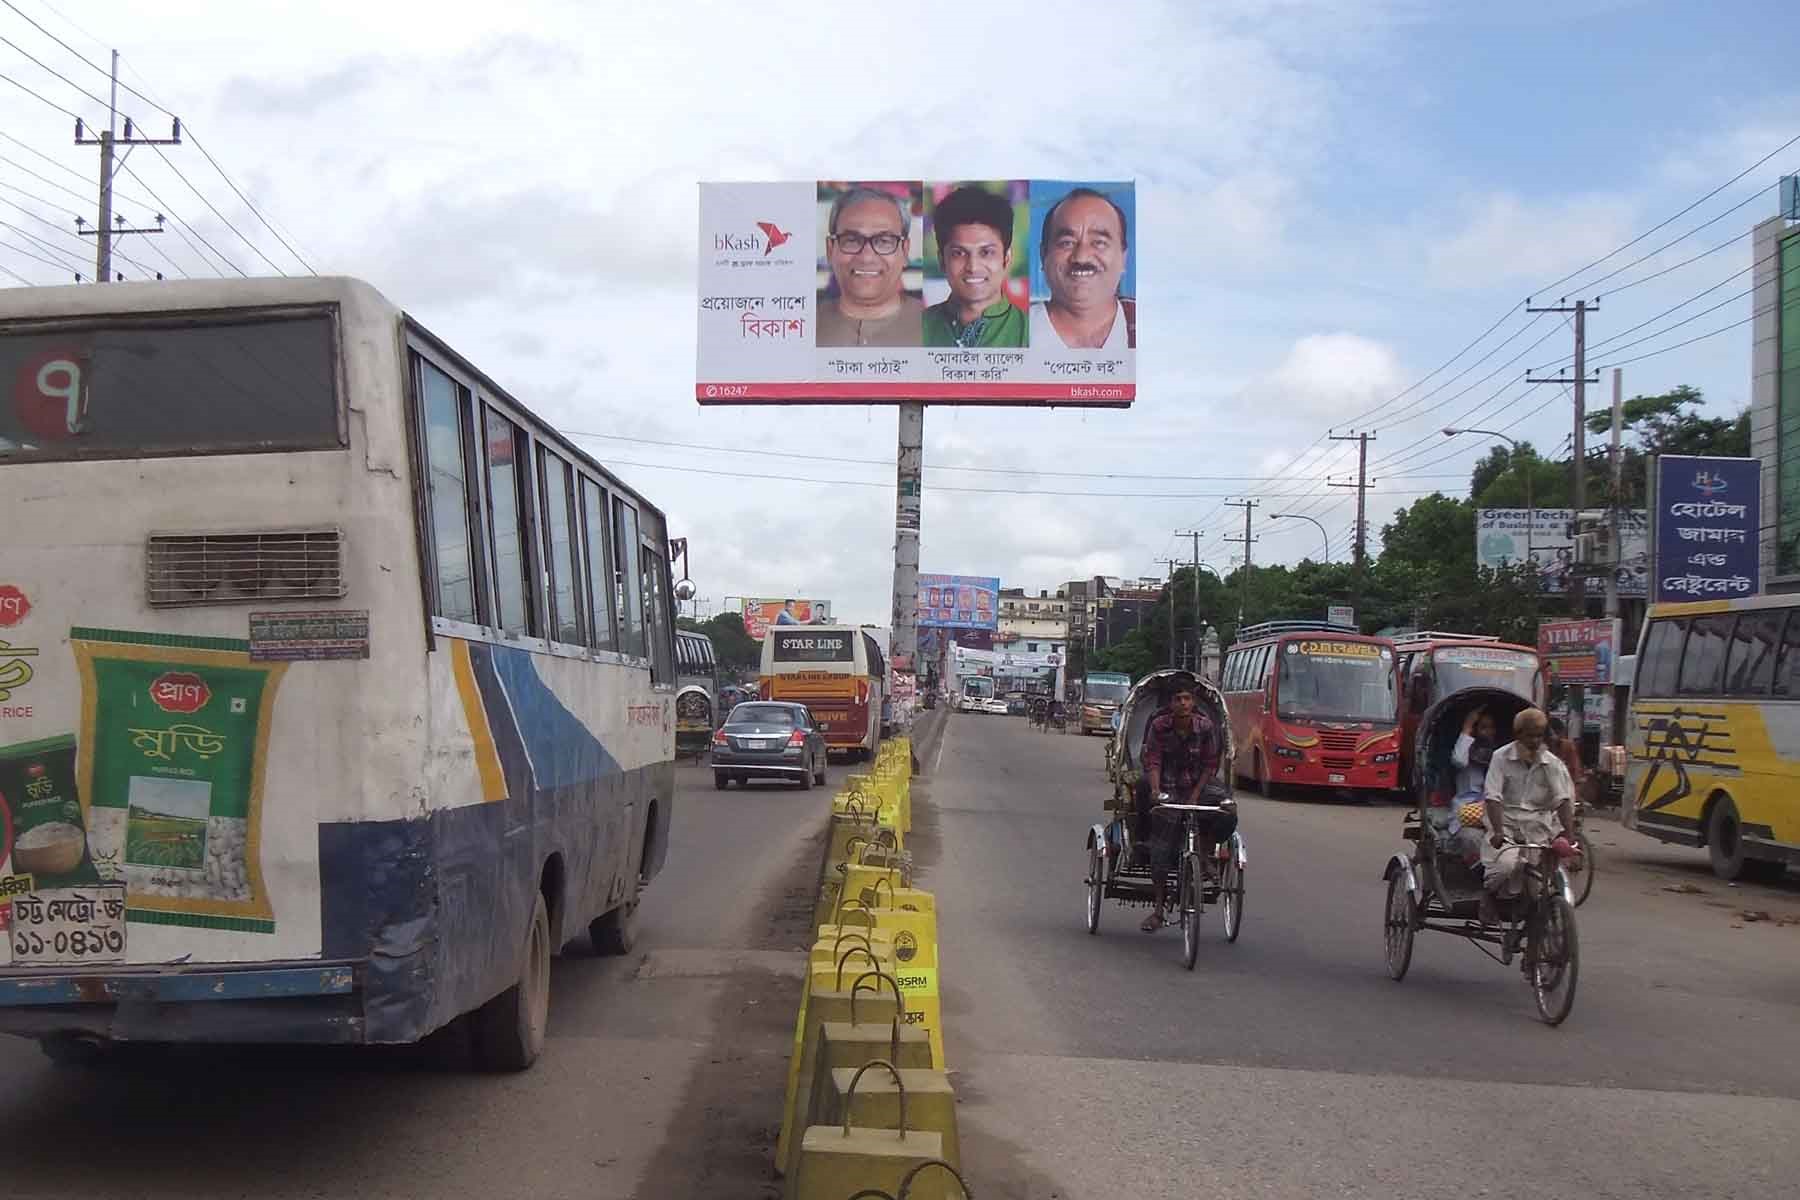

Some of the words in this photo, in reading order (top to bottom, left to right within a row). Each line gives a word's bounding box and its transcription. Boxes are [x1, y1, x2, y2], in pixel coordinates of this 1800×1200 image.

[713, 232, 760, 251] bKash
[702, 296, 765, 310] প্রয়োজনে
[771, 296, 807, 310] পাশে
[740, 312, 805, 338] বিকাশ
[719, 385, 748, 396] 16247
[1071, 387, 1122, 397] bkash.com
[1483, 509, 1529, 520] Green
[1535, 509, 1569, 520] Tech
[1670, 500, 1747, 518] হোটেল
[1676, 527, 1746, 543] জামান
[782, 639, 814, 649] STAR
[817, 639, 843, 649] LINE
[158, 682, 201, 703] প্রাণ
[3, 706, 33, 718] RICE
[127, 723, 227, 761] মুড়ি
[898, 976, 927, 986] BSRM
